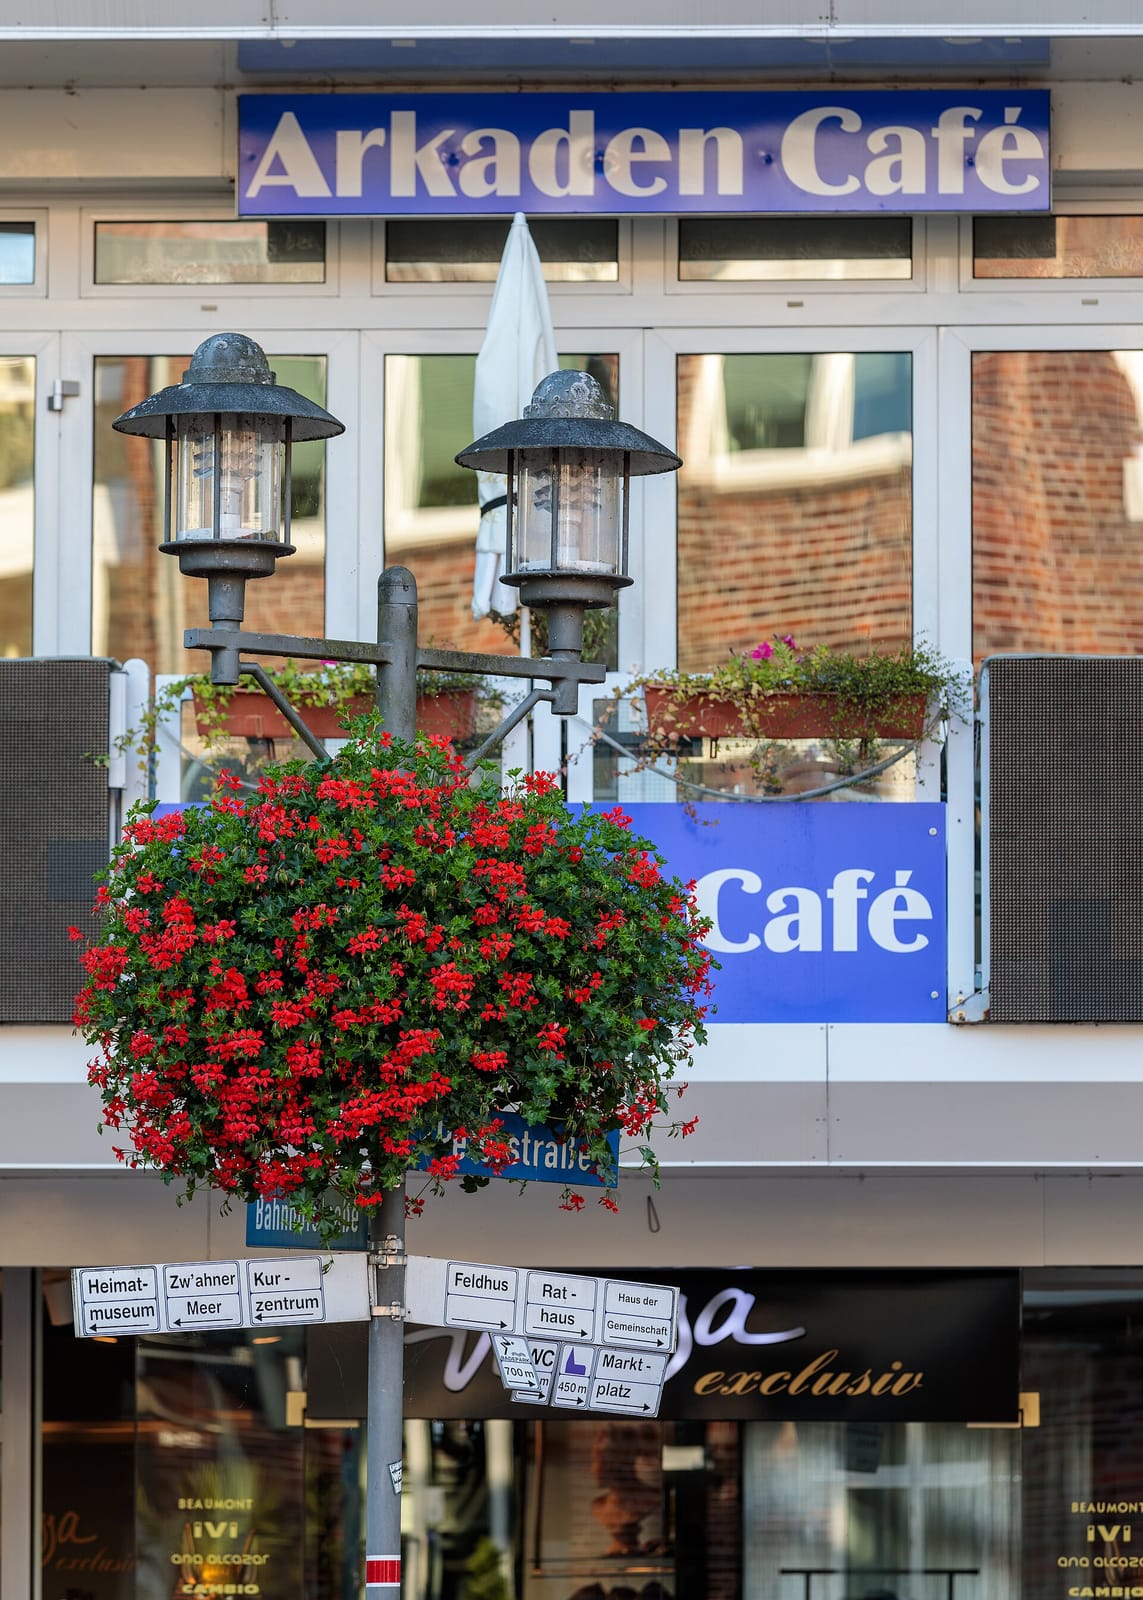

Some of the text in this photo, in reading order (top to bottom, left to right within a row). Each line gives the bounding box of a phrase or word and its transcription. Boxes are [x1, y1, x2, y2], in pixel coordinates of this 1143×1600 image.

[245, 105, 1045, 198] Arkaden Café
[687, 868, 933, 954] Café
[88, 1276, 149, 1295] Heimat-
[169, 1272, 236, 1290] Zw'ahner
[454, 1271, 509, 1292] Feldhus
[186, 1300, 222, 1316] Meer
[255, 1295, 319, 1312] zentrum
[618, 1293, 659, 1307] Haus der
[89, 1303, 155, 1321] museum
[540, 1308, 575, 1326] haus
[606, 1320, 668, 1337] Gemeinschaft
[504, 1366, 535, 1379] 700 m
[694, 1349, 924, 1396] exclusiv
[558, 1381, 587, 1394] 450 m
[596, 1382, 632, 1399] platz
[178, 1498, 253, 1510] BEAUMONT
[182, 1583, 260, 1595] CAMBIO
